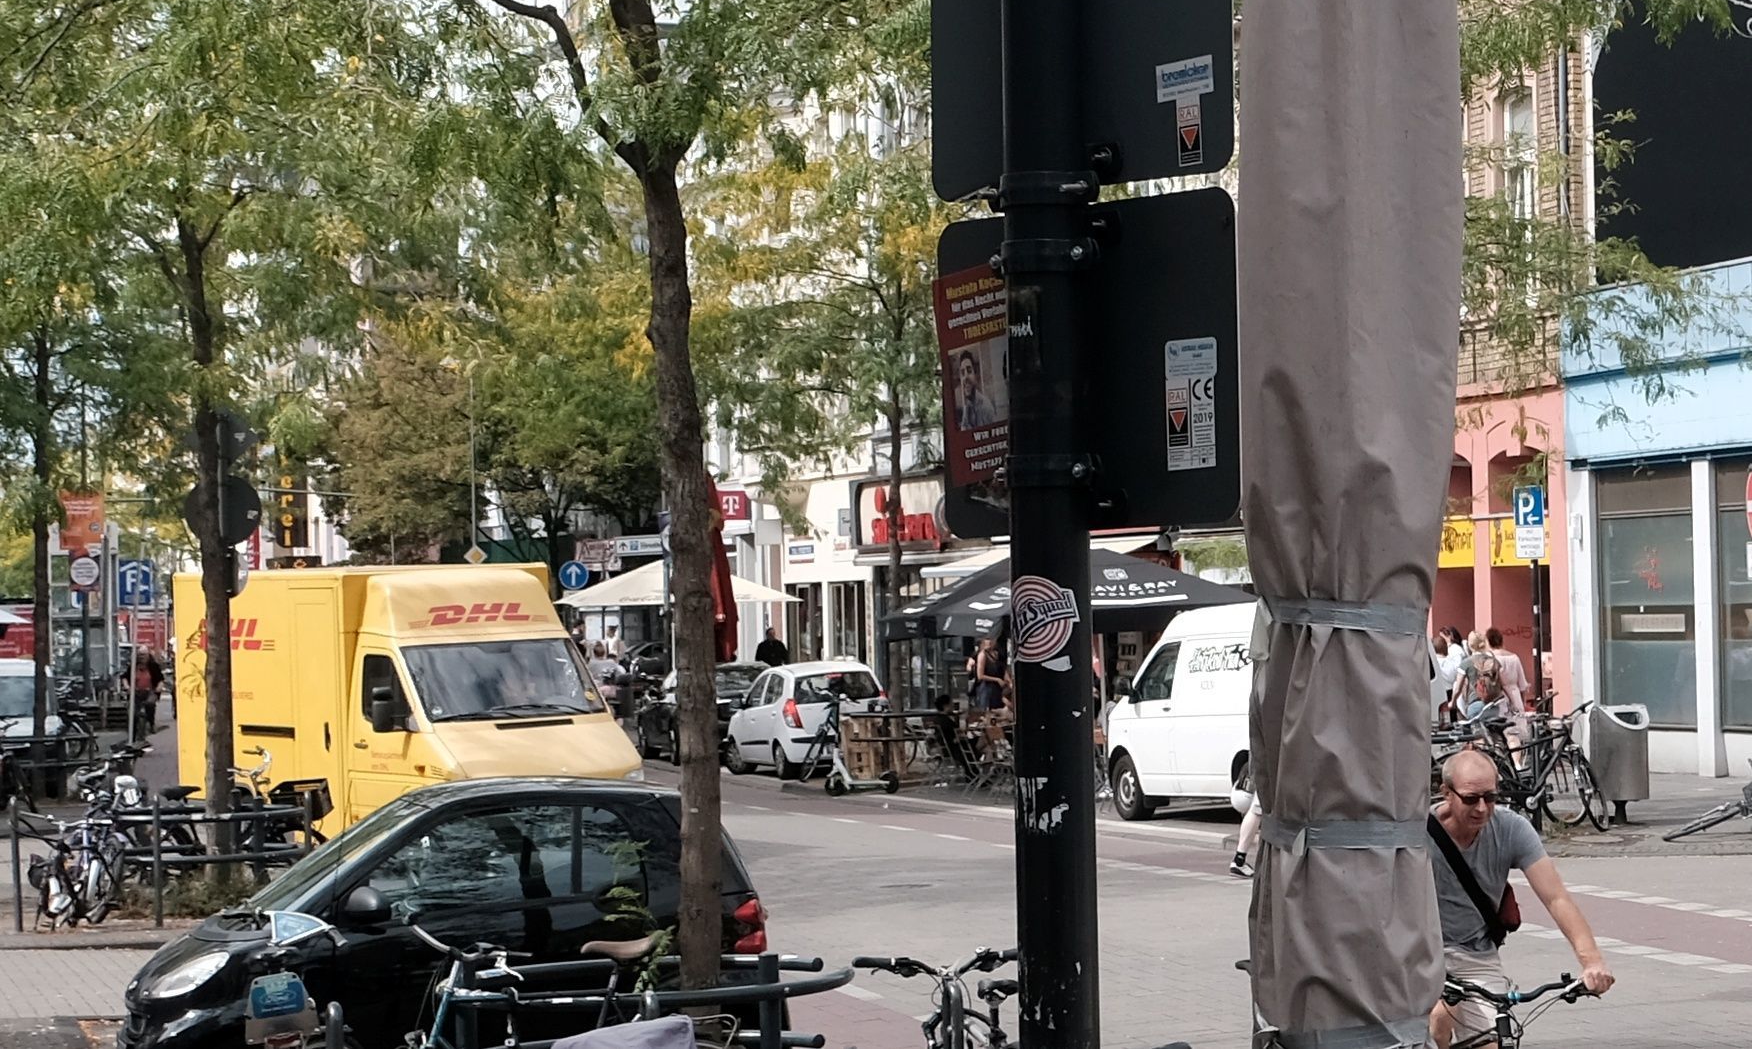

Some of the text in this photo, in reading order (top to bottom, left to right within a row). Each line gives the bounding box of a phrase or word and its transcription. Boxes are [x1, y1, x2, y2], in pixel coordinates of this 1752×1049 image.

[1168, 391, 1186, 403] RAL
[1193, 411, 1213, 424] 2019
[722, 495, 740, 516] T
[1518, 492, 1535, 526] P
[428, 602, 531, 627] DHL
